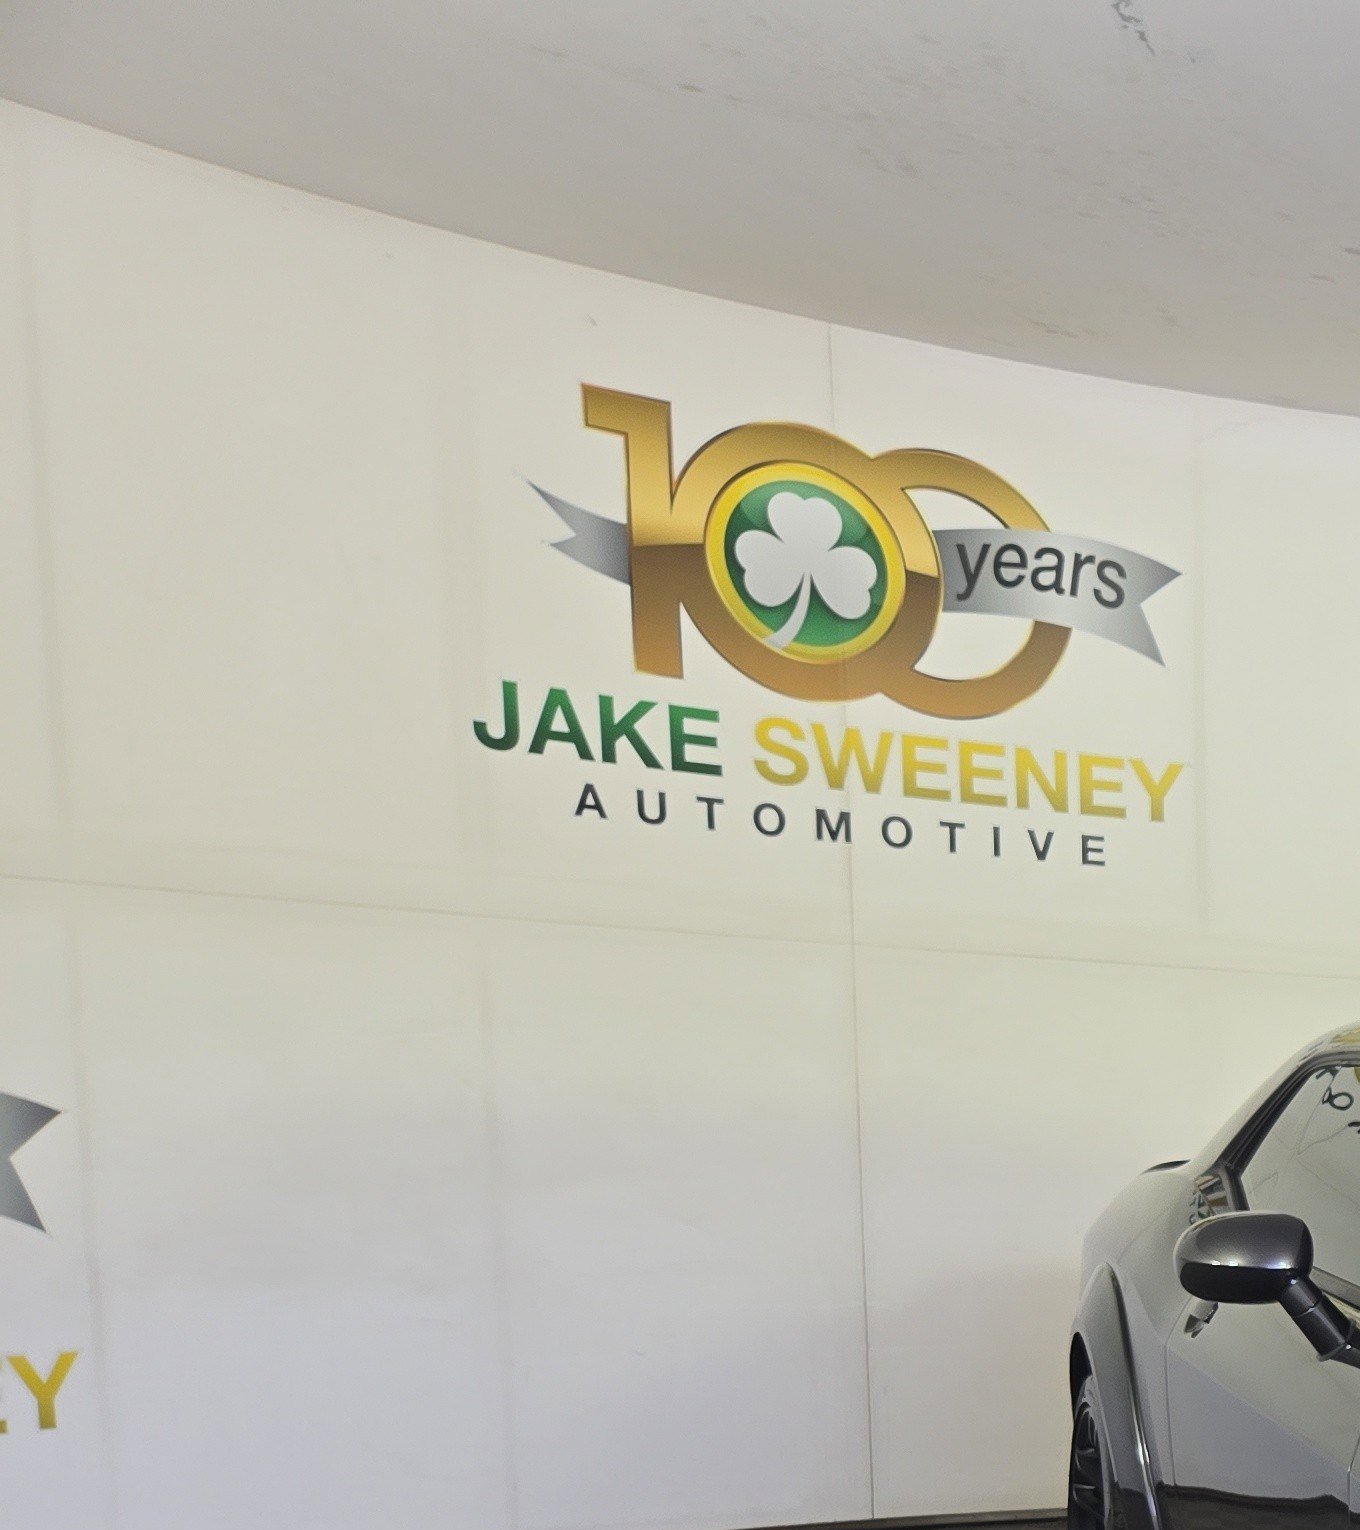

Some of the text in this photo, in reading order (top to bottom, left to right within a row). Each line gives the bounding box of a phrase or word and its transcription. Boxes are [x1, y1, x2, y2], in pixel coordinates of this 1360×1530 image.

[581, 382, 1128, 720] 100 years
[472, 680, 1184, 823] JAKE SWEENEY
[574, 783, 1106, 866] AUTOMOTIVE
